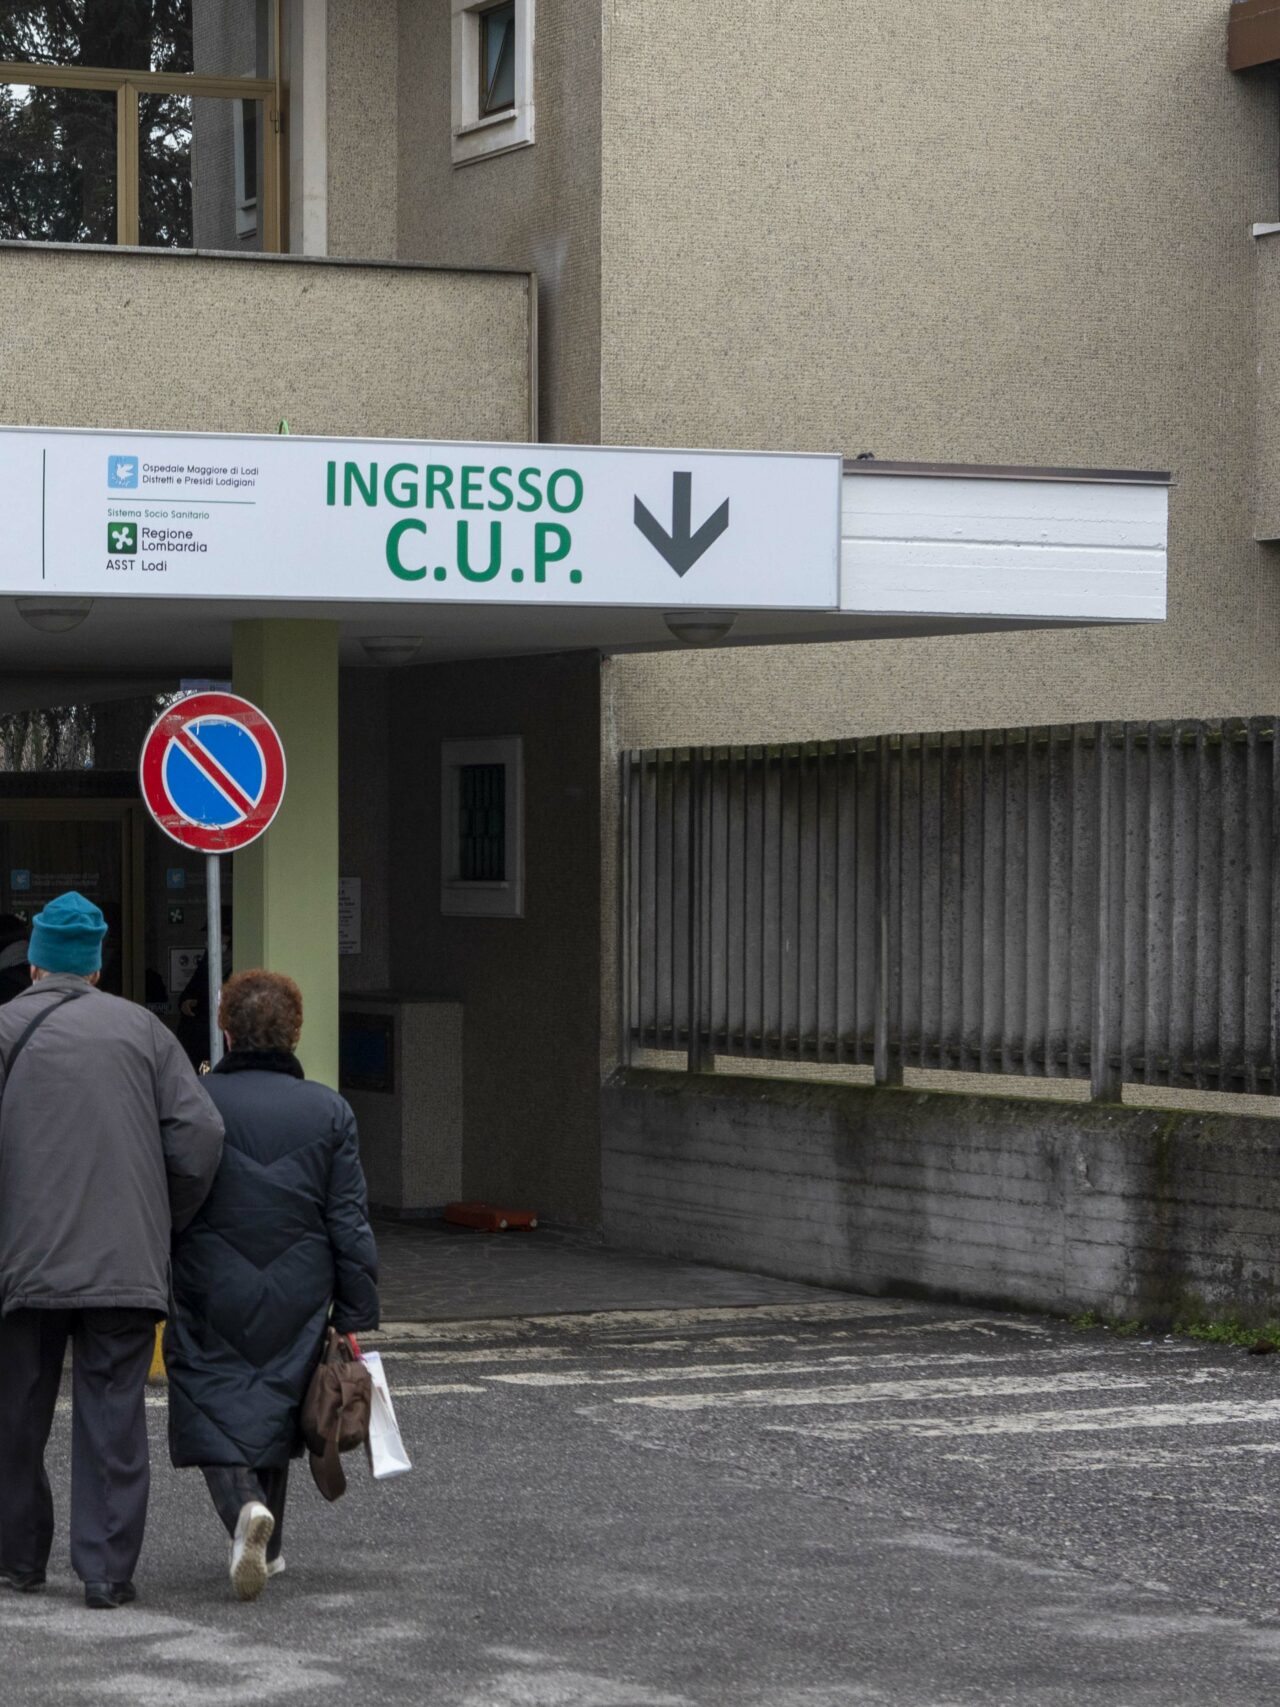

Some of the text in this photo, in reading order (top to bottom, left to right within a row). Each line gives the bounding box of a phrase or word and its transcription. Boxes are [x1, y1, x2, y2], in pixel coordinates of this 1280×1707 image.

[142, 464, 259, 476] Ospedale Maggiore di Lodi
[142, 475, 174, 484] Distretti
[184, 476, 214, 486] Presidi
[215, 477, 255, 488] Lodigiani
[326, 460, 584, 514] INGRESSO
[107, 508, 210, 520] Sistema Socio Sanitario
[142, 527, 193, 541] Regione
[142, 540, 208, 553] Lombardia
[385, 517, 583, 584] C.U.P.
[106, 559, 167, 572] ASST Lodi
